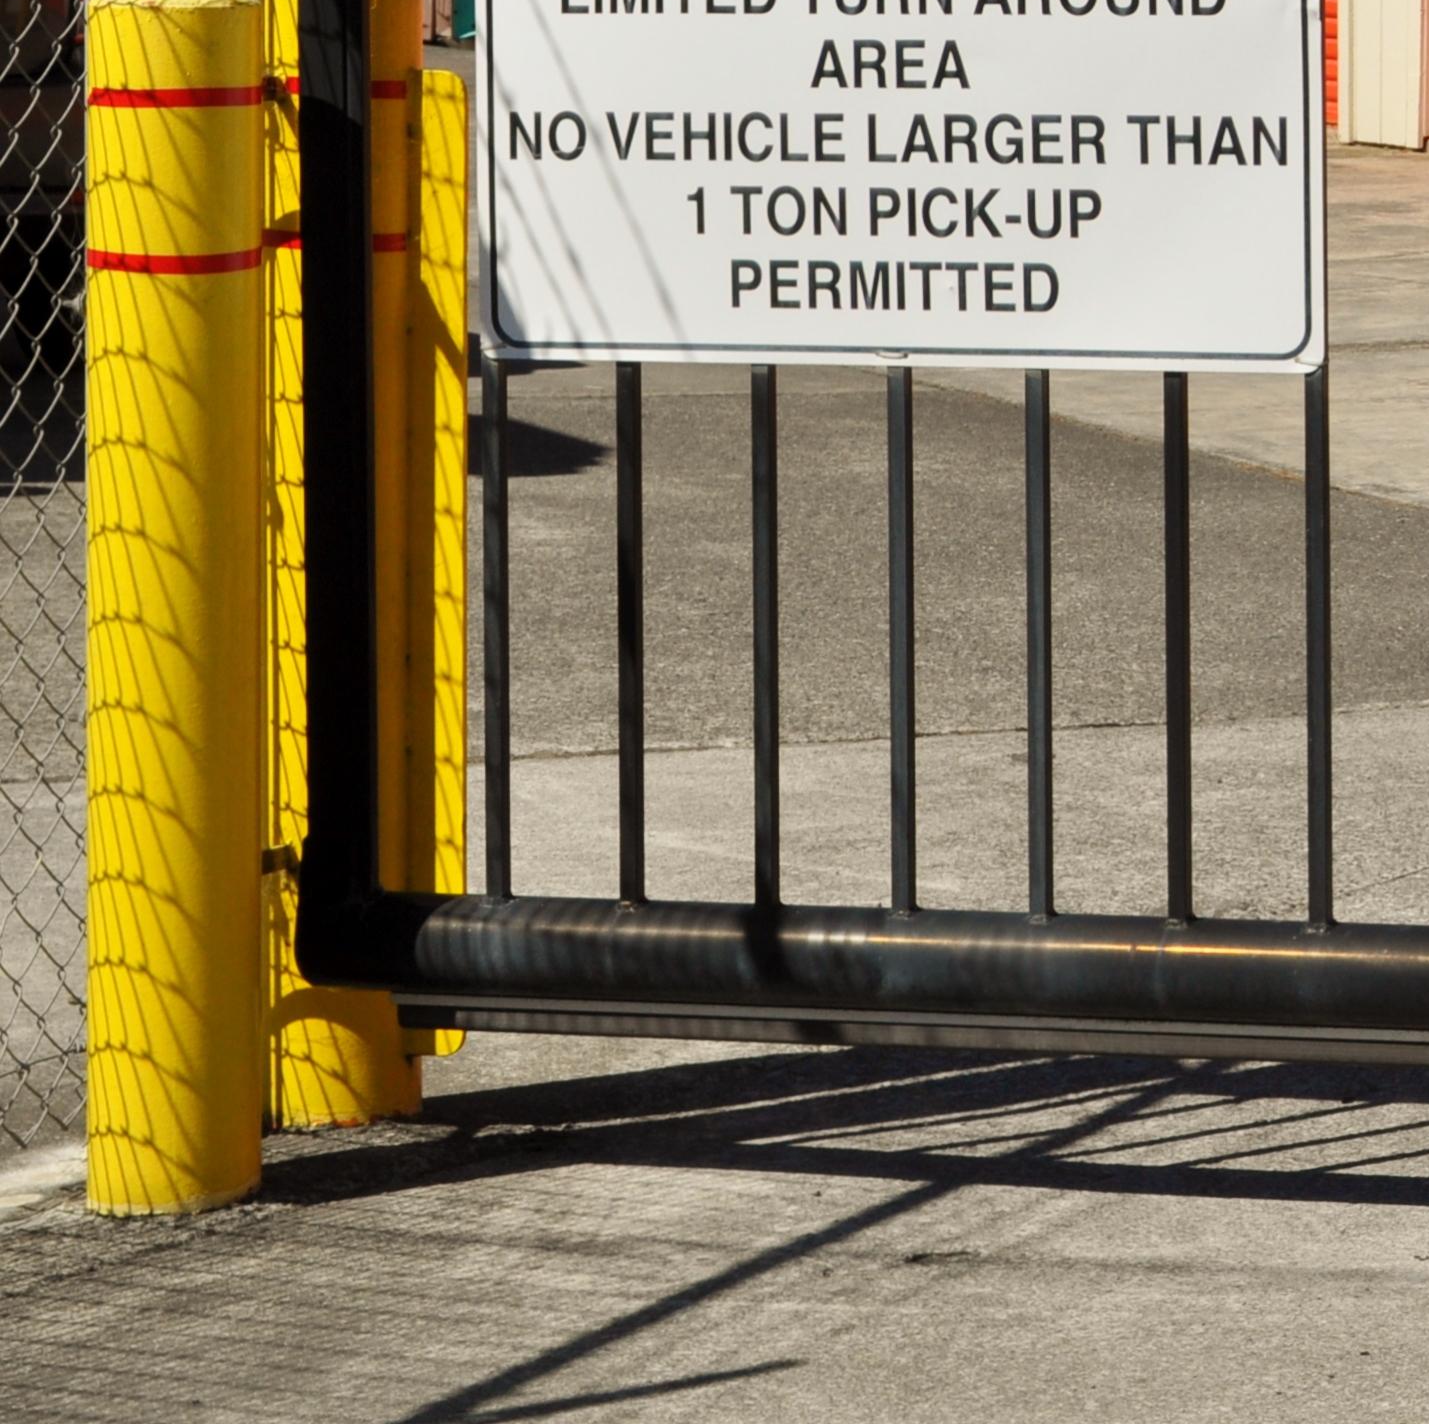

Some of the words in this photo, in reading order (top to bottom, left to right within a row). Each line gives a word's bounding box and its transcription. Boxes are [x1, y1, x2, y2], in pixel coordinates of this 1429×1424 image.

[811, 40, 969, 88] AREA
[509, 111, 586, 161] NO
[607, 112, 845, 162] VEHICLE
[868, 114, 1105, 164] LARGER
[1127, 116, 1287, 166] THAN
[688, 187, 704, 234] 1
[731, 186, 847, 236] TON
[870, 188, 1101, 238] PICK-UP
[731, 260, 1059, 312] PERMITTED
